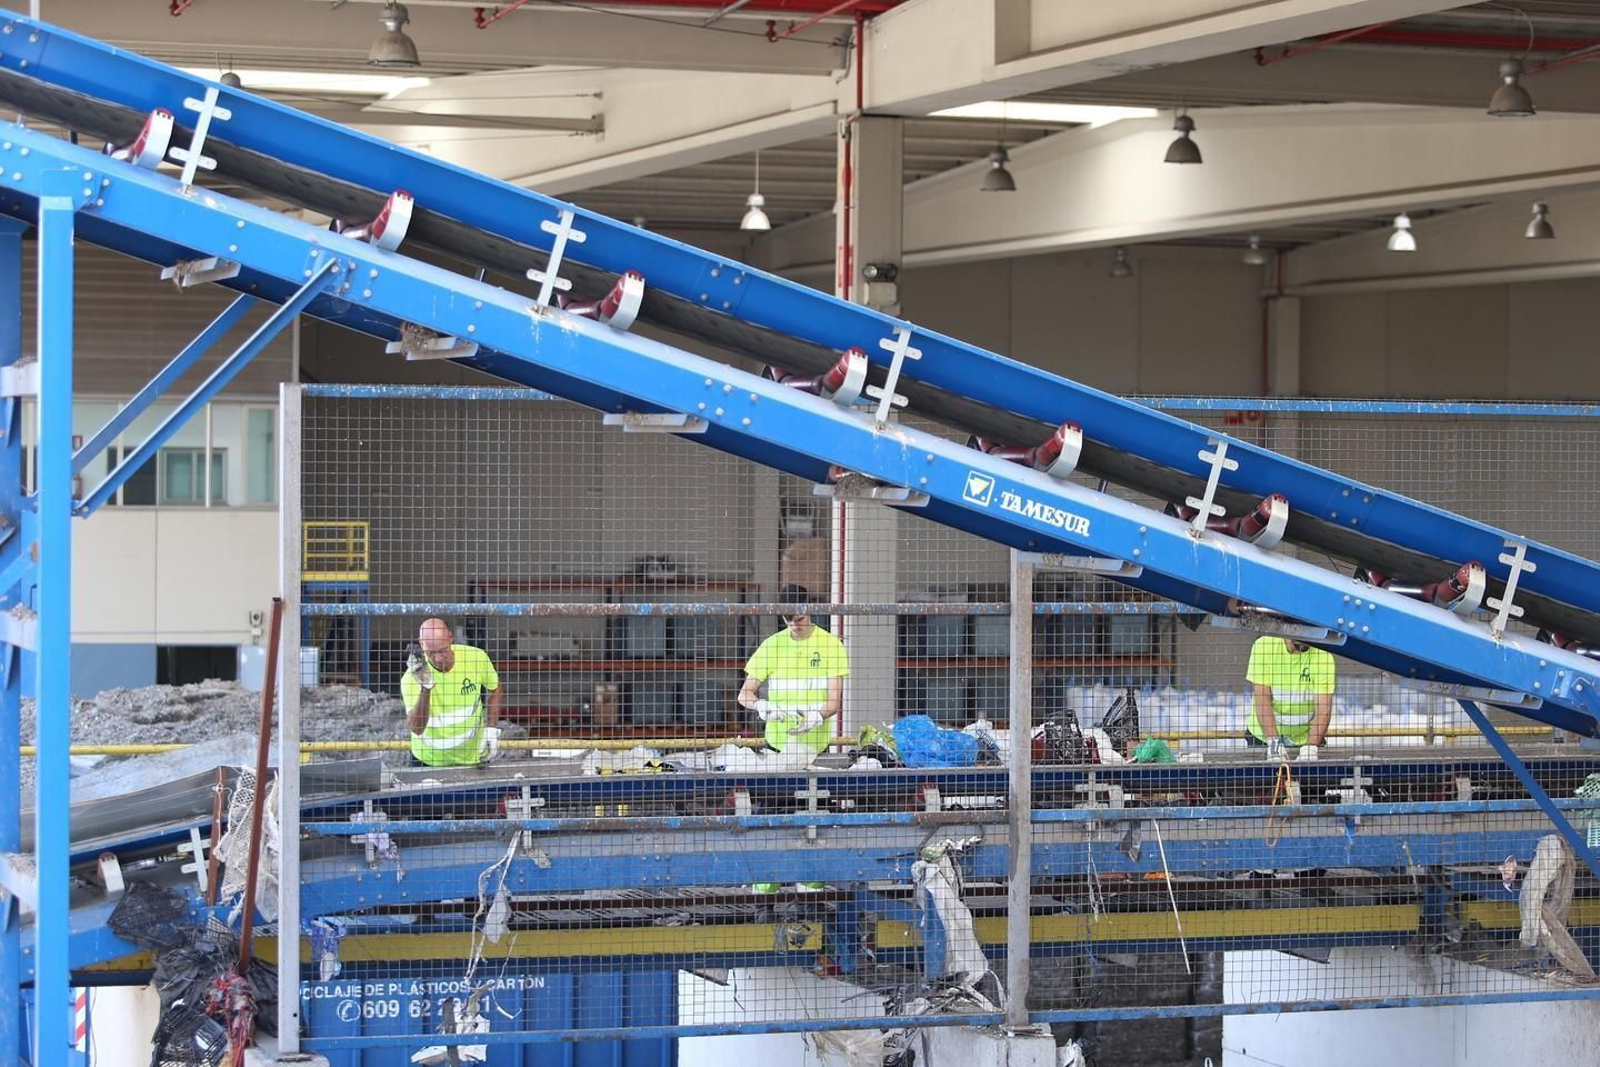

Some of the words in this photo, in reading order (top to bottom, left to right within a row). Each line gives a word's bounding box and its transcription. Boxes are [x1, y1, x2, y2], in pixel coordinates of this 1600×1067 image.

[1000, 491, 1090, 537] TAMESUR
[299, 985, 362, 1000] CICLAJE
[365, 983, 385, 996] DE
[362, 1000, 400, 1018] 609
[409, 999, 431, 1018] 62
